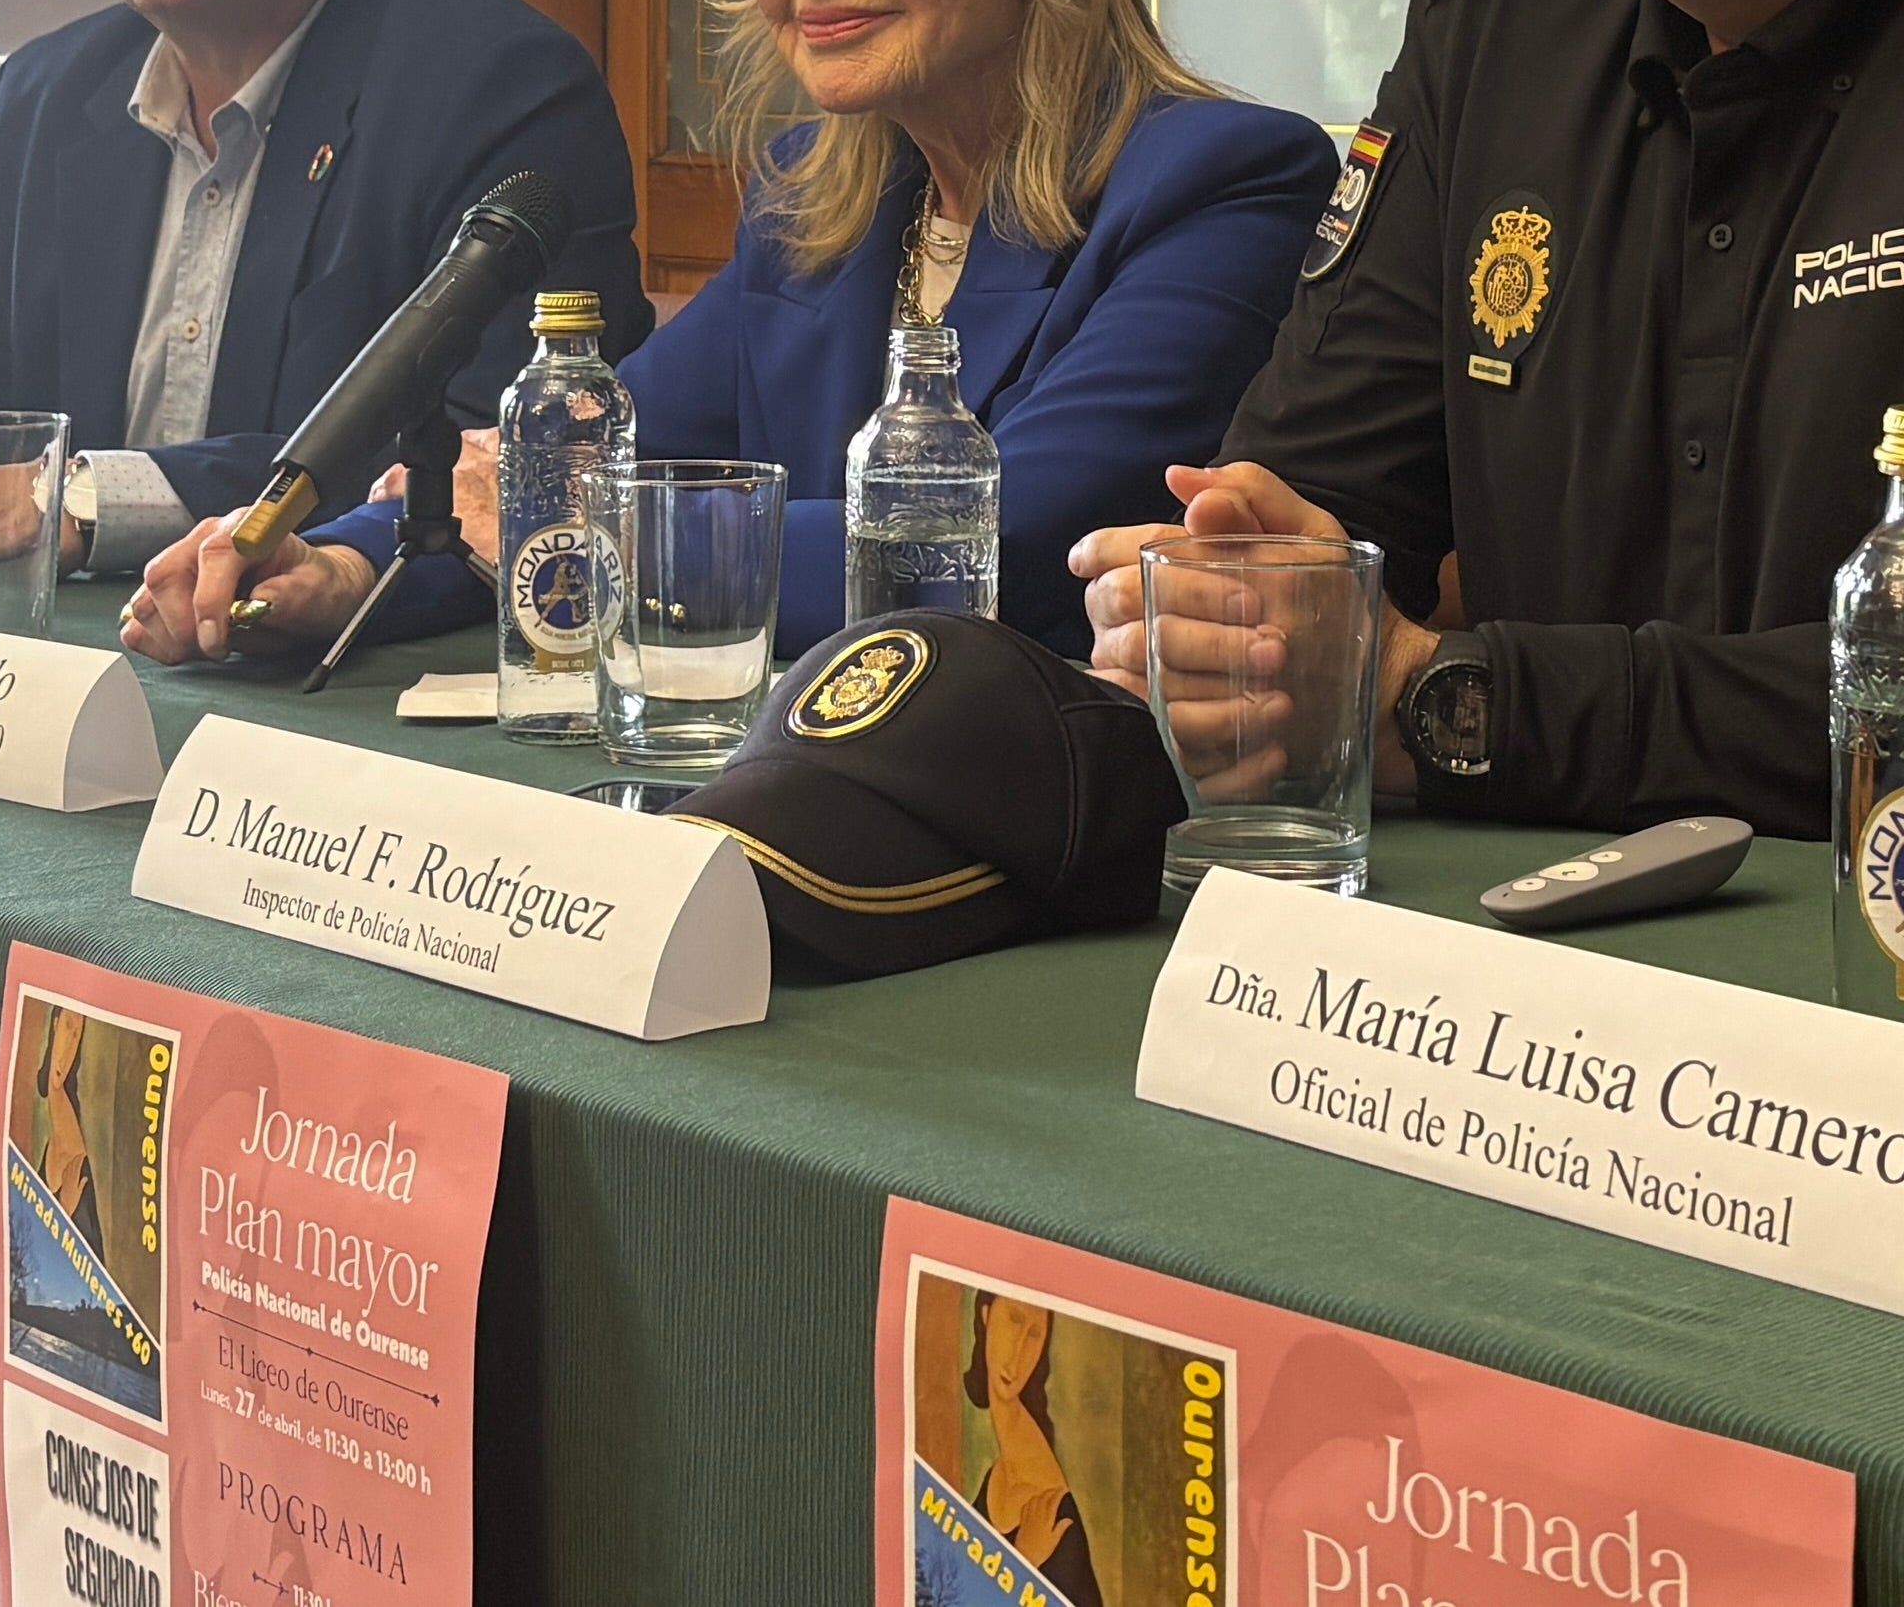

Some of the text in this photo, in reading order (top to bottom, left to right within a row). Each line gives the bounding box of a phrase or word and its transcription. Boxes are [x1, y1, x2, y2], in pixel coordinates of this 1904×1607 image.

[181, 787, 616, 942] D. Manuel F. Rodríguez
[242, 878, 501, 973] Inspector de Policía Nacional
[1206, 962, 1282, 1023] Dña.
[1296, 966, 1458, 1067] María
[1472, 1011, 1636, 1114] Luisa
[142, 1043, 170, 1253] Ourense
[240, 1086, 417, 1204] Jornada
[1269, 1059, 1794, 1247] Oficial de Policía Nacional
[11, 1162, 152, 1365] Mirada Mulleres +60
[199, 1166, 439, 1318] Plan mayor
[202, 1261, 429, 1370] Policía Nacional de Ourense
[201, 1380, 431, 1495] Lunes, 27 de abril, de 11:30 a 13:00 h
[219, 1335, 409, 1440] El Liceo de Ourense
[46, 1429, 161, 1550] CONSEJOS DE
[219, 1461, 407, 1585] PROGRAMA
[921, 1487, 1014, 1593] Mirada
[1366, 1434, 1690, 1607] Jornada
[65, 1526, 161, 1607] SEGURIDAD
